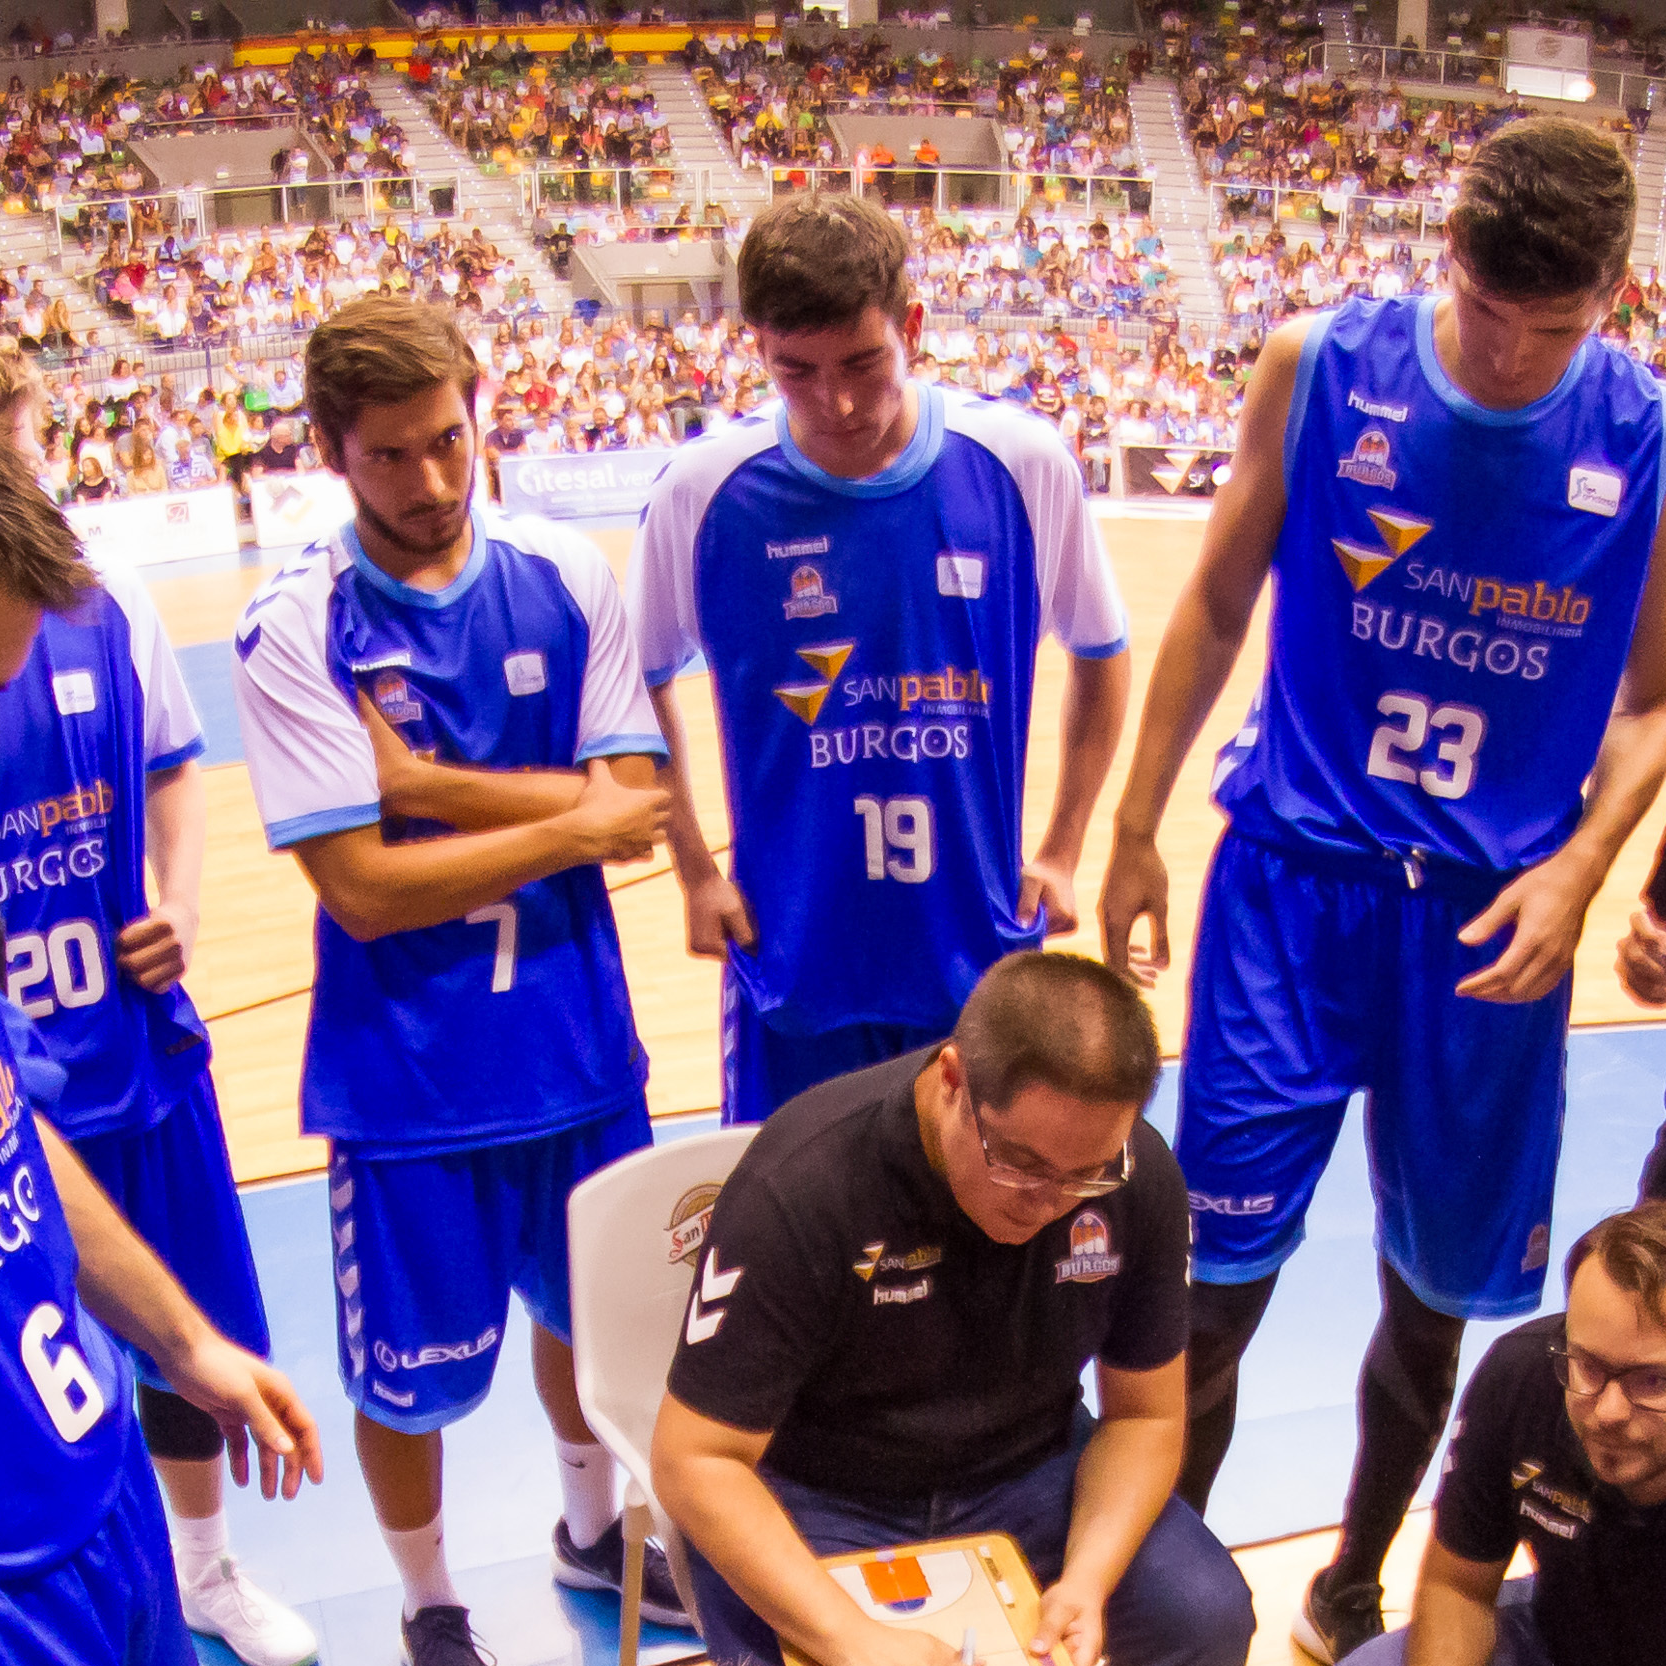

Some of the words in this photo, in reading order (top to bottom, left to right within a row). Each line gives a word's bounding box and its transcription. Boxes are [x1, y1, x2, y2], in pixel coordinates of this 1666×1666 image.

[1347, 391, 1409, 423] hummel
[1350, 601, 1550, 681] BURGOS
[809, 723, 969, 768] BURGOS
[1367, 695, 1483, 800] 23
[854, 798, 933, 884] 19
[5, 921, 106, 1020] 20
[455, 904, 517, 993] 7
[669, 1225, 701, 1264] San
[21, 1302, 105, 1443] 6
[402, 1327, 499, 1369] LEXUS
